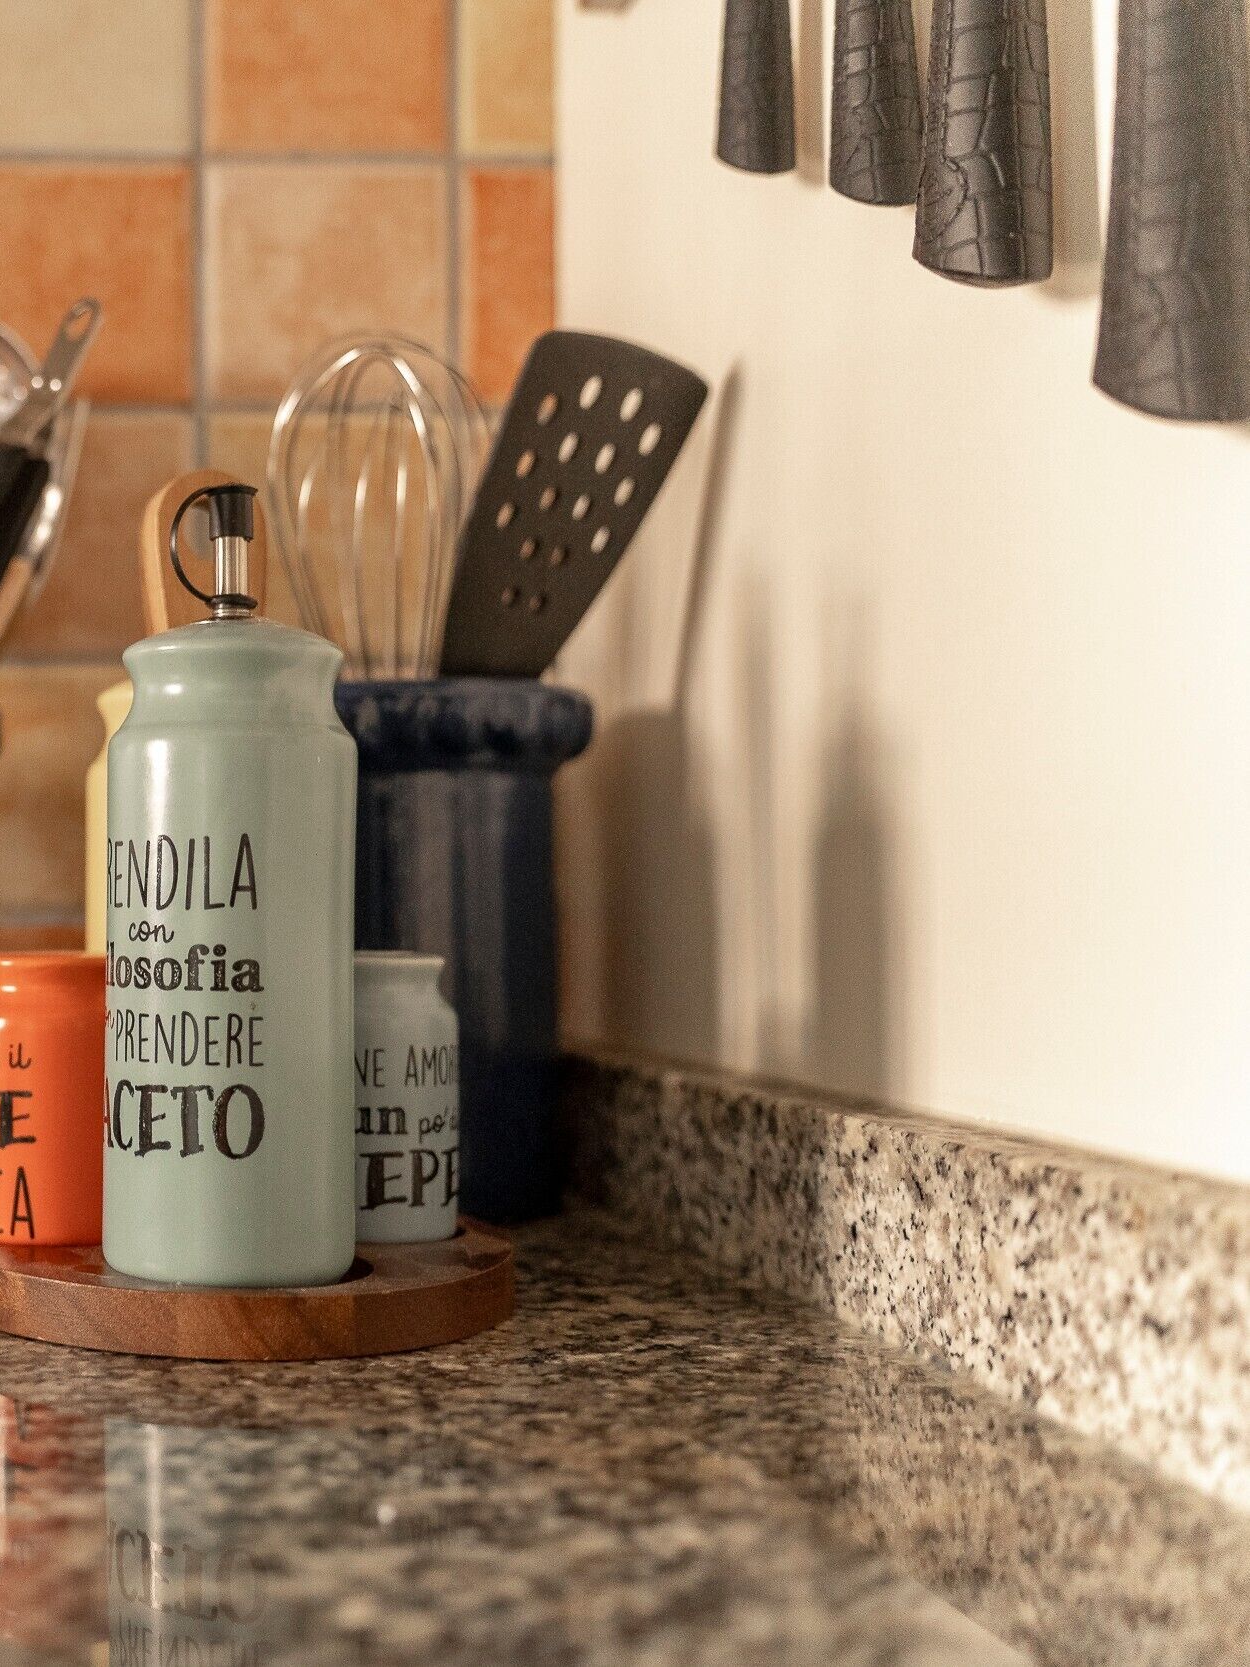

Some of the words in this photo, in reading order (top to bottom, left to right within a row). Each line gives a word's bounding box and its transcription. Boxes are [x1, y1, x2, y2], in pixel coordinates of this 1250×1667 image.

[129, 920, 175, 944] con
[116, 1009, 264, 1068] PRENDERE
[8, 1042, 32, 1069] il
